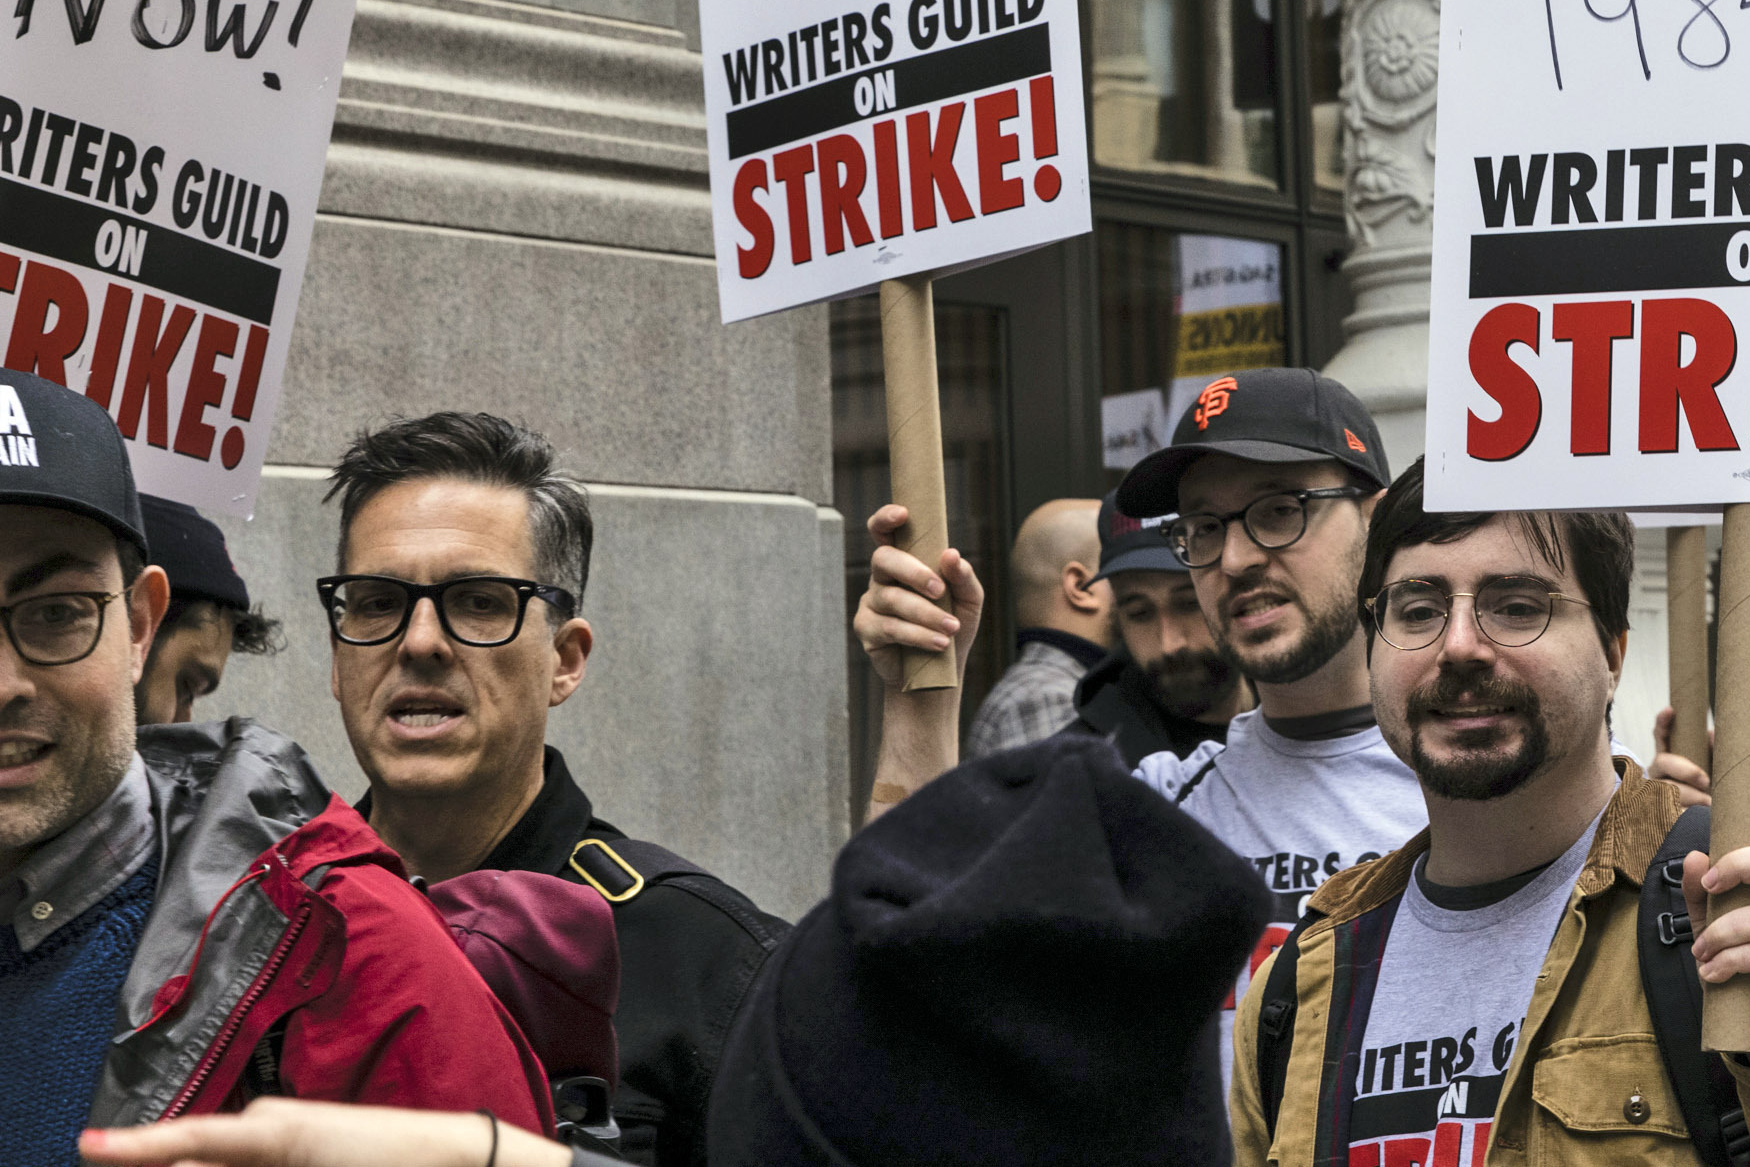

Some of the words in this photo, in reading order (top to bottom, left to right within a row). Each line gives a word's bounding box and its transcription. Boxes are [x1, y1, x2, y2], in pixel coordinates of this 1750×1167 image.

[722, 1, 894, 107] WRITERS
[853, 68, 897, 117] ON
[172, 158, 290, 260] GUILD
[732, 74, 1062, 280] STRIKE!
[95, 219, 148, 277] ON
[0, 251, 270, 471] RIKE!
